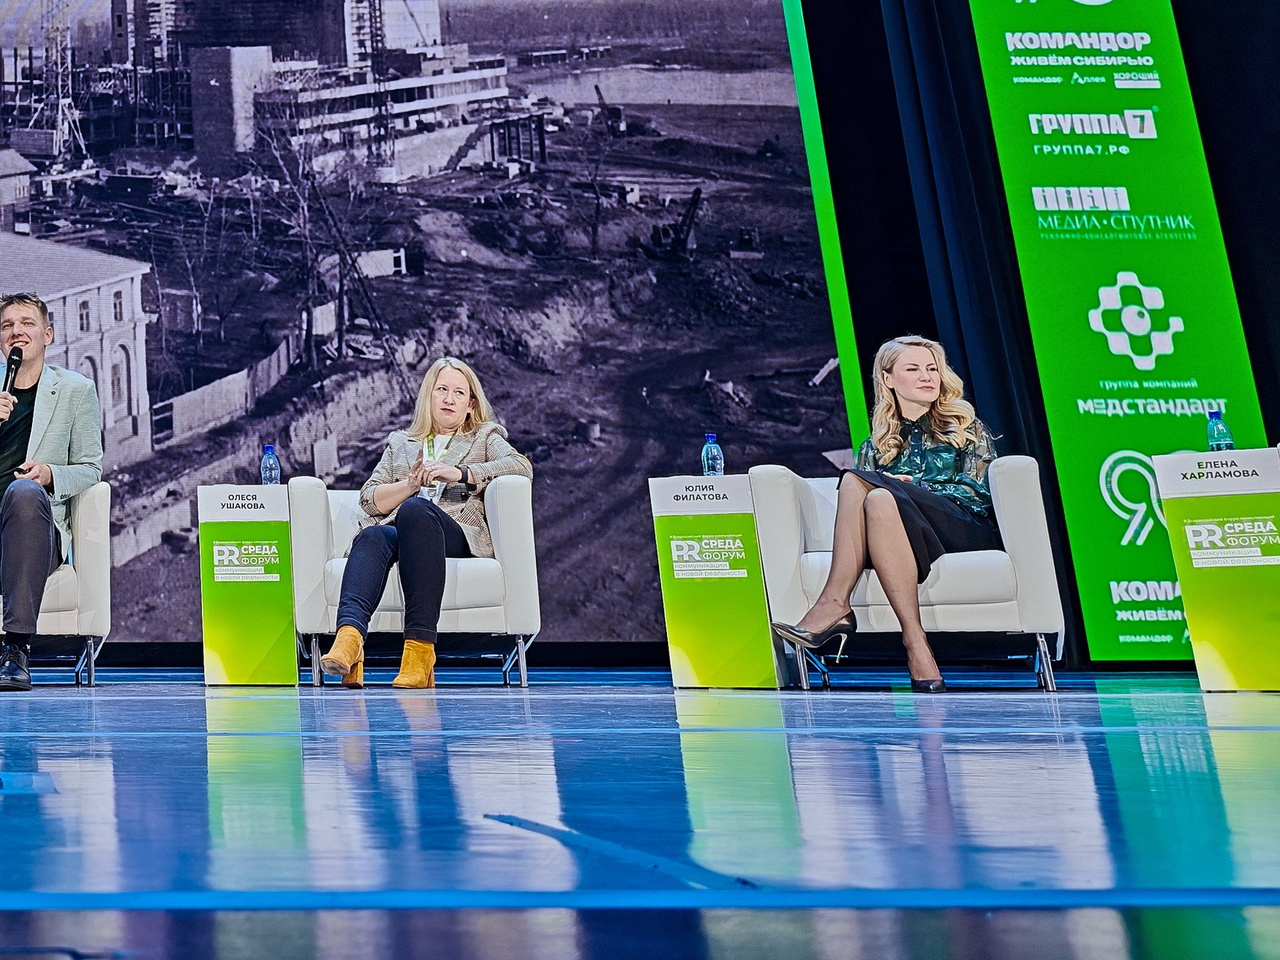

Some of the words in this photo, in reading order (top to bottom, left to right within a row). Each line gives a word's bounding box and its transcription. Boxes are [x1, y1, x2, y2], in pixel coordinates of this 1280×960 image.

[1004, 32, 1151, 52] КОМАНДОР
[1072, 56, 1154, 66] СИБИРЬЮ
[1033, 144, 1130, 155] ГРУППА7.РФ
[1099, 380, 1139, 390] группа
[1197, 460, 1238, 469] ЕЛЕНА
[1181, 469, 1260, 480] ХАРЛАМОВА
[685, 484, 715, 492] ЮЛИЯ
[673, 493, 729, 501] ФИЛАТОВА
[1224, 521, 1278, 533] СРЕДА
[1185, 524, 1226, 549] PR
[1227, 536, 1280, 546] ФОРУМ
[701, 539, 744, 549] СРЕДА
[241, 545, 278, 554] СРЕДА
[670, 540, 701, 561] PR
[213, 545, 240, 565] PR
[702, 551, 746, 560] ФОРУМ
[241, 557, 280, 565] ФОРУМ
